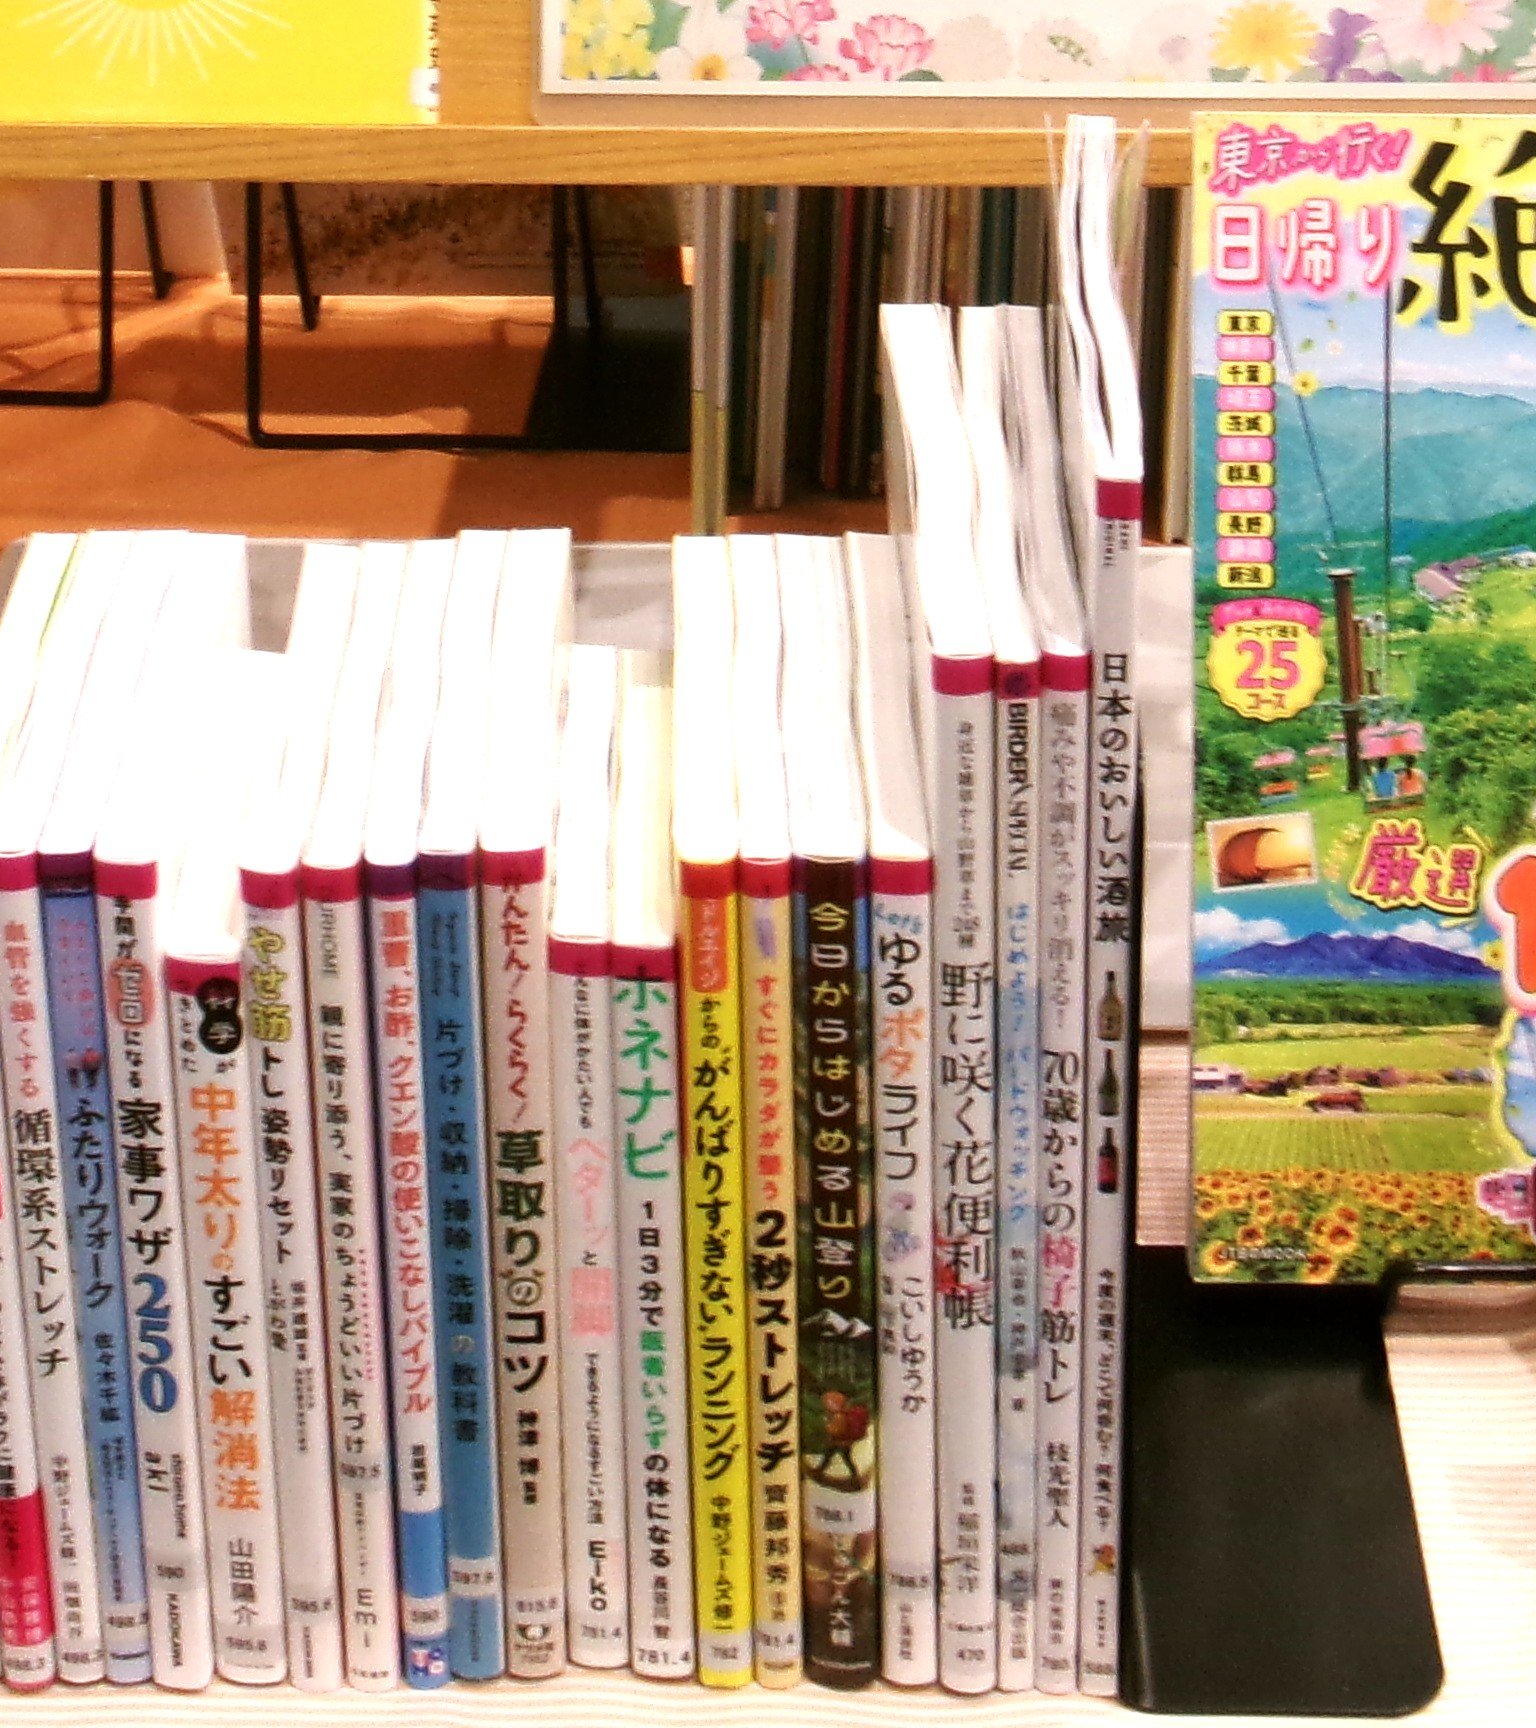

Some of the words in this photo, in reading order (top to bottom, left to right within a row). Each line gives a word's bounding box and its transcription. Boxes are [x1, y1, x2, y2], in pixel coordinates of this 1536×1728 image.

[1214, 198, 1394, 286] 日帰り
[1226, 315, 1262, 333] 東京
[1226, 365, 1261, 384] 千葉
[1226, 465, 1262, 485] 群馬
[1226, 515, 1263, 535] 長野
[1007, 702, 1030, 782] BIRDER
[1234, 639, 1301, 691] 25
[1246, 692, 1287, 710] コース
[1094, 652, 1132, 943] 日本のおいしい酒旅
[1355, 820, 1478, 910] 厳選
[3, 922, 41, 1100] 血管を強くする
[319, 900, 339, 978] URHOME
[612, 979, 678, 1180] ホネナビ
[808, 901, 856, 1300] 今日からはじめる山登り
[876, 933, 926, 1181] ゆるポタライフ
[939, 961, 994, 1330] 野に咲く花便利帳
[10, 1107, 70, 1378] 循環系ストレッチ
[68, 1098, 117, 1311] ふたりウォーク
[116, 1098, 179, 1416] 家事ワザ250
[188, 1082, 264, 1512] 中年太りのすごい解消法
[494, 1128, 551, 1394] 草取りのコツ
[1041, 1049, 1081, 1404] 70歳からの椅子筋トレ
[750, 1208, 796, 1475] 2秒ストレッチ
